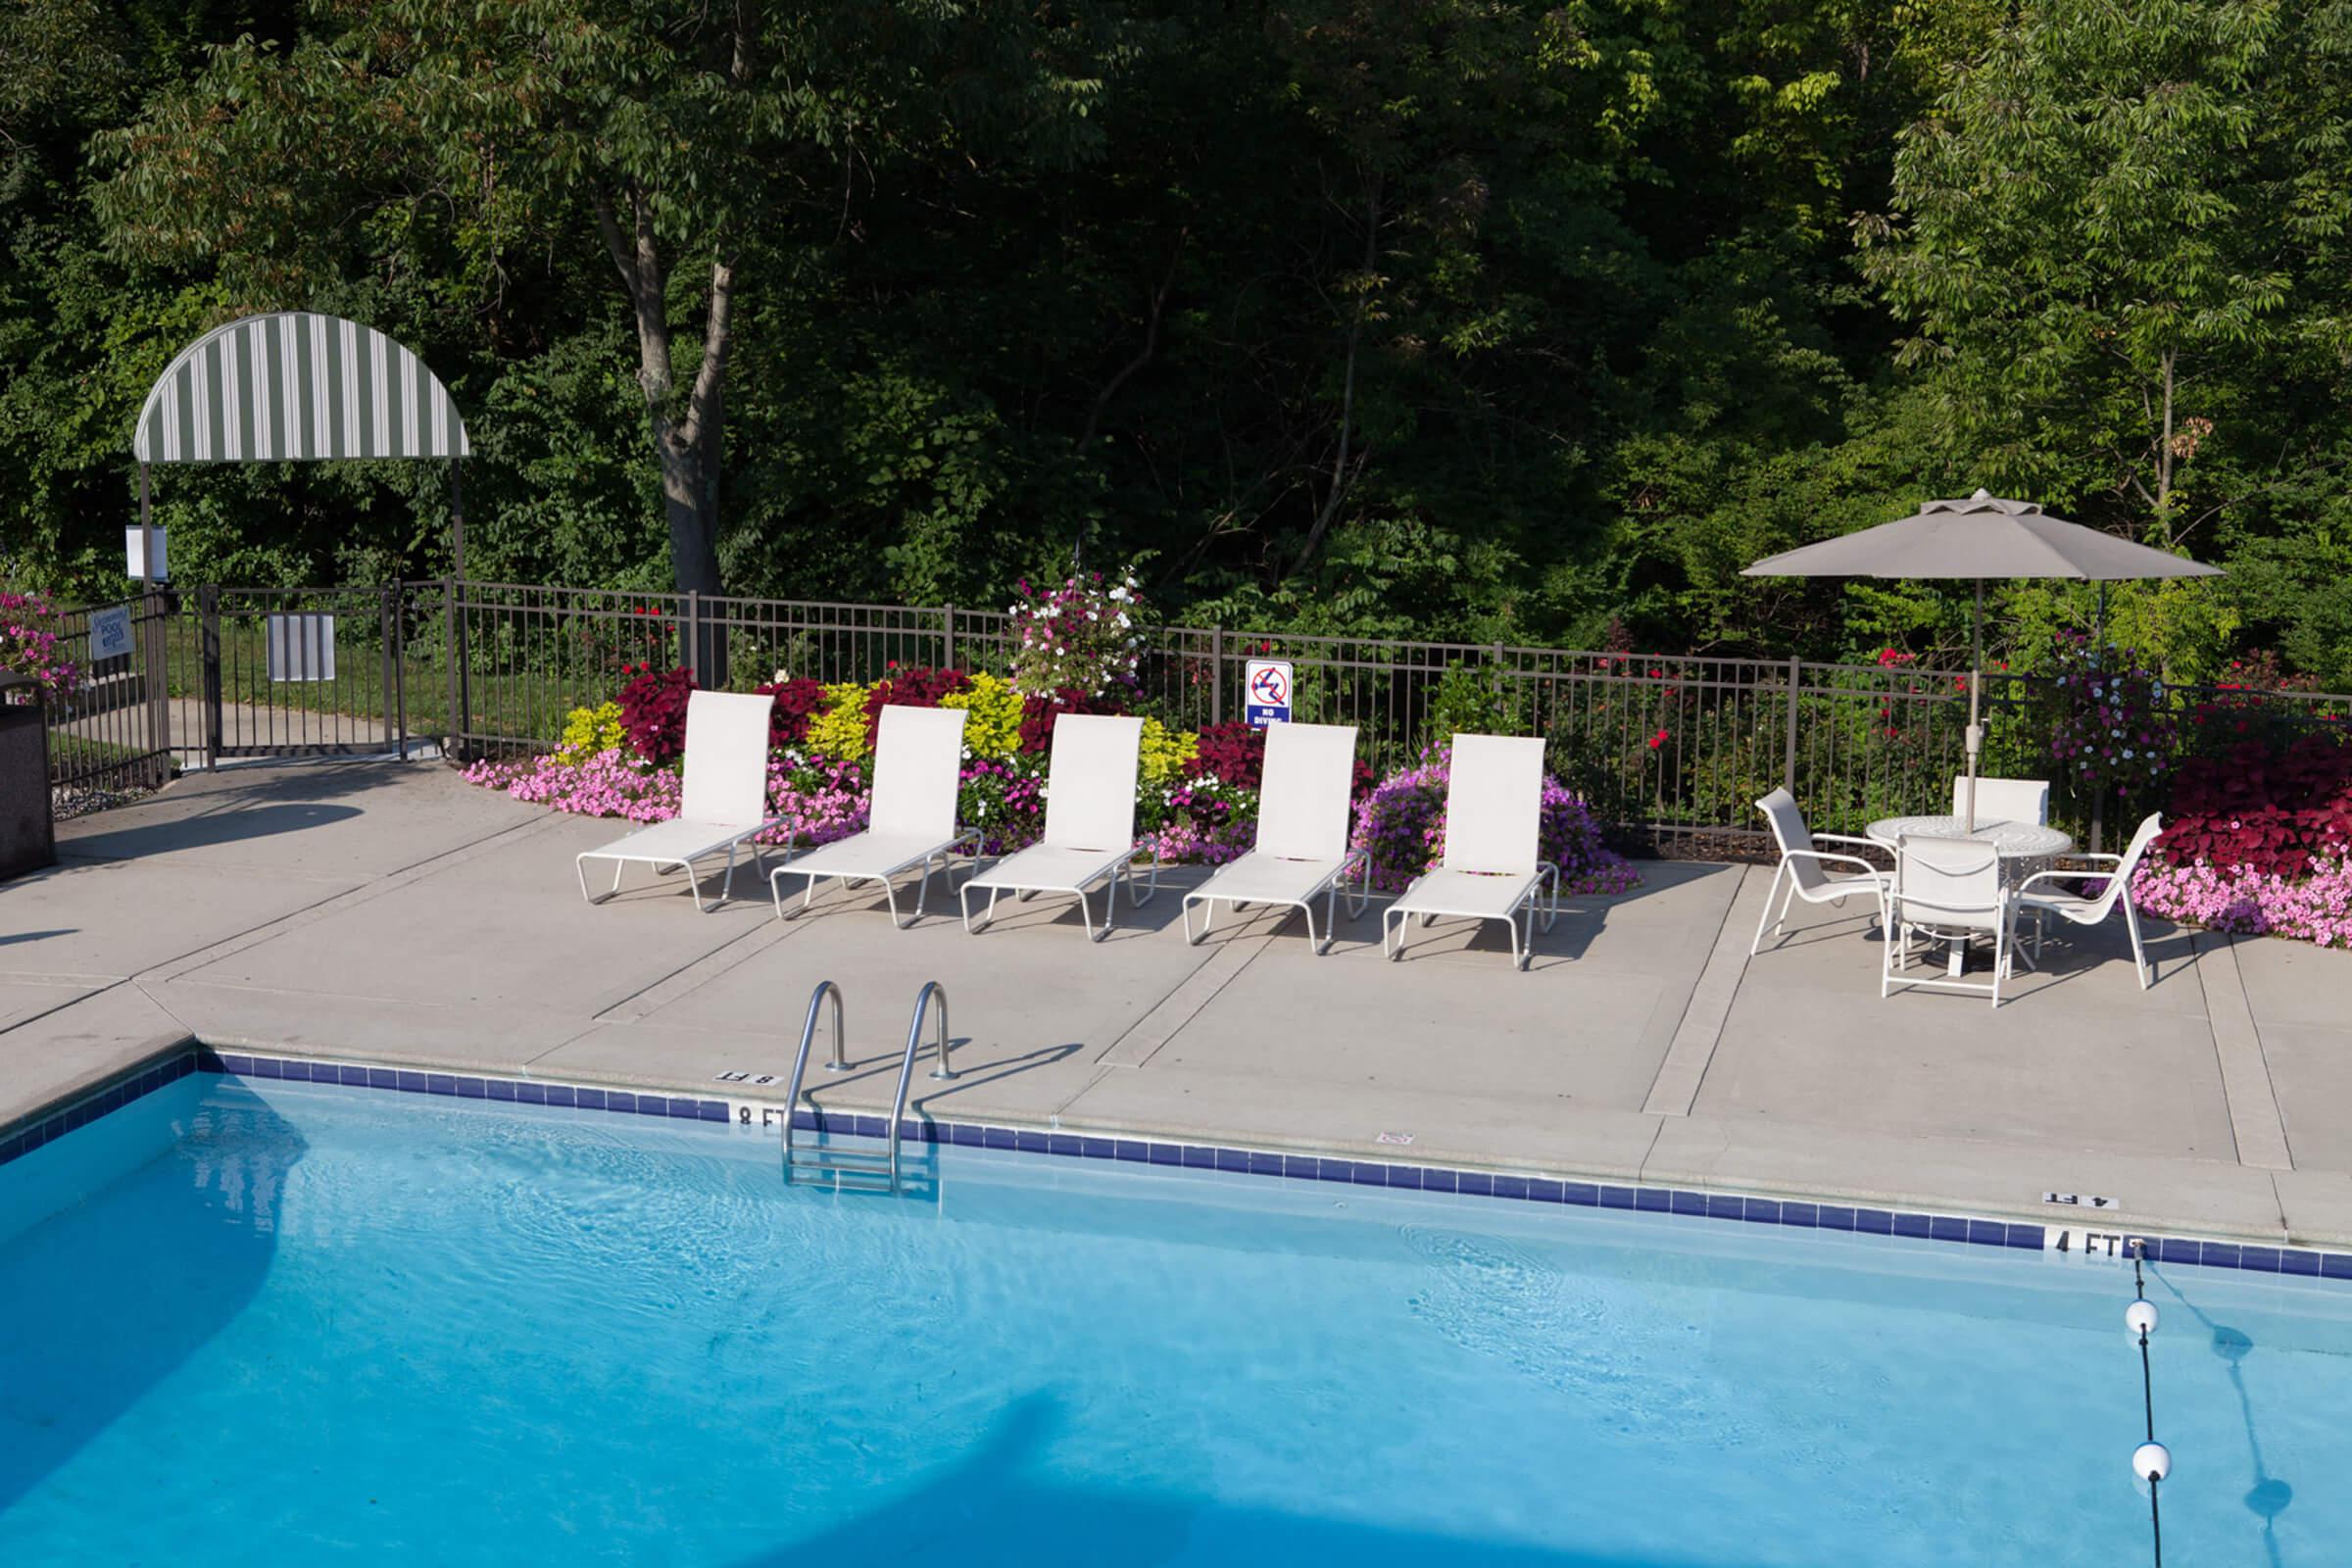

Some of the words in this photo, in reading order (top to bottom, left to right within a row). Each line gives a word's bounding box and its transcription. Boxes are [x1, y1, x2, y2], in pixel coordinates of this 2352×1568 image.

[1261, 708, 1274, 717] NO
[714, 1072, 750, 1081] FT
[755, 1075, 774, 1084] 8
[739, 1105, 752, 1125] 8
[2045, 1193, 2079, 1205] FT
[2092, 1197, 2108, 1206] 4
[2055, 1230, 2070, 1252] 4
[2085, 1233, 2120, 1256] FT
